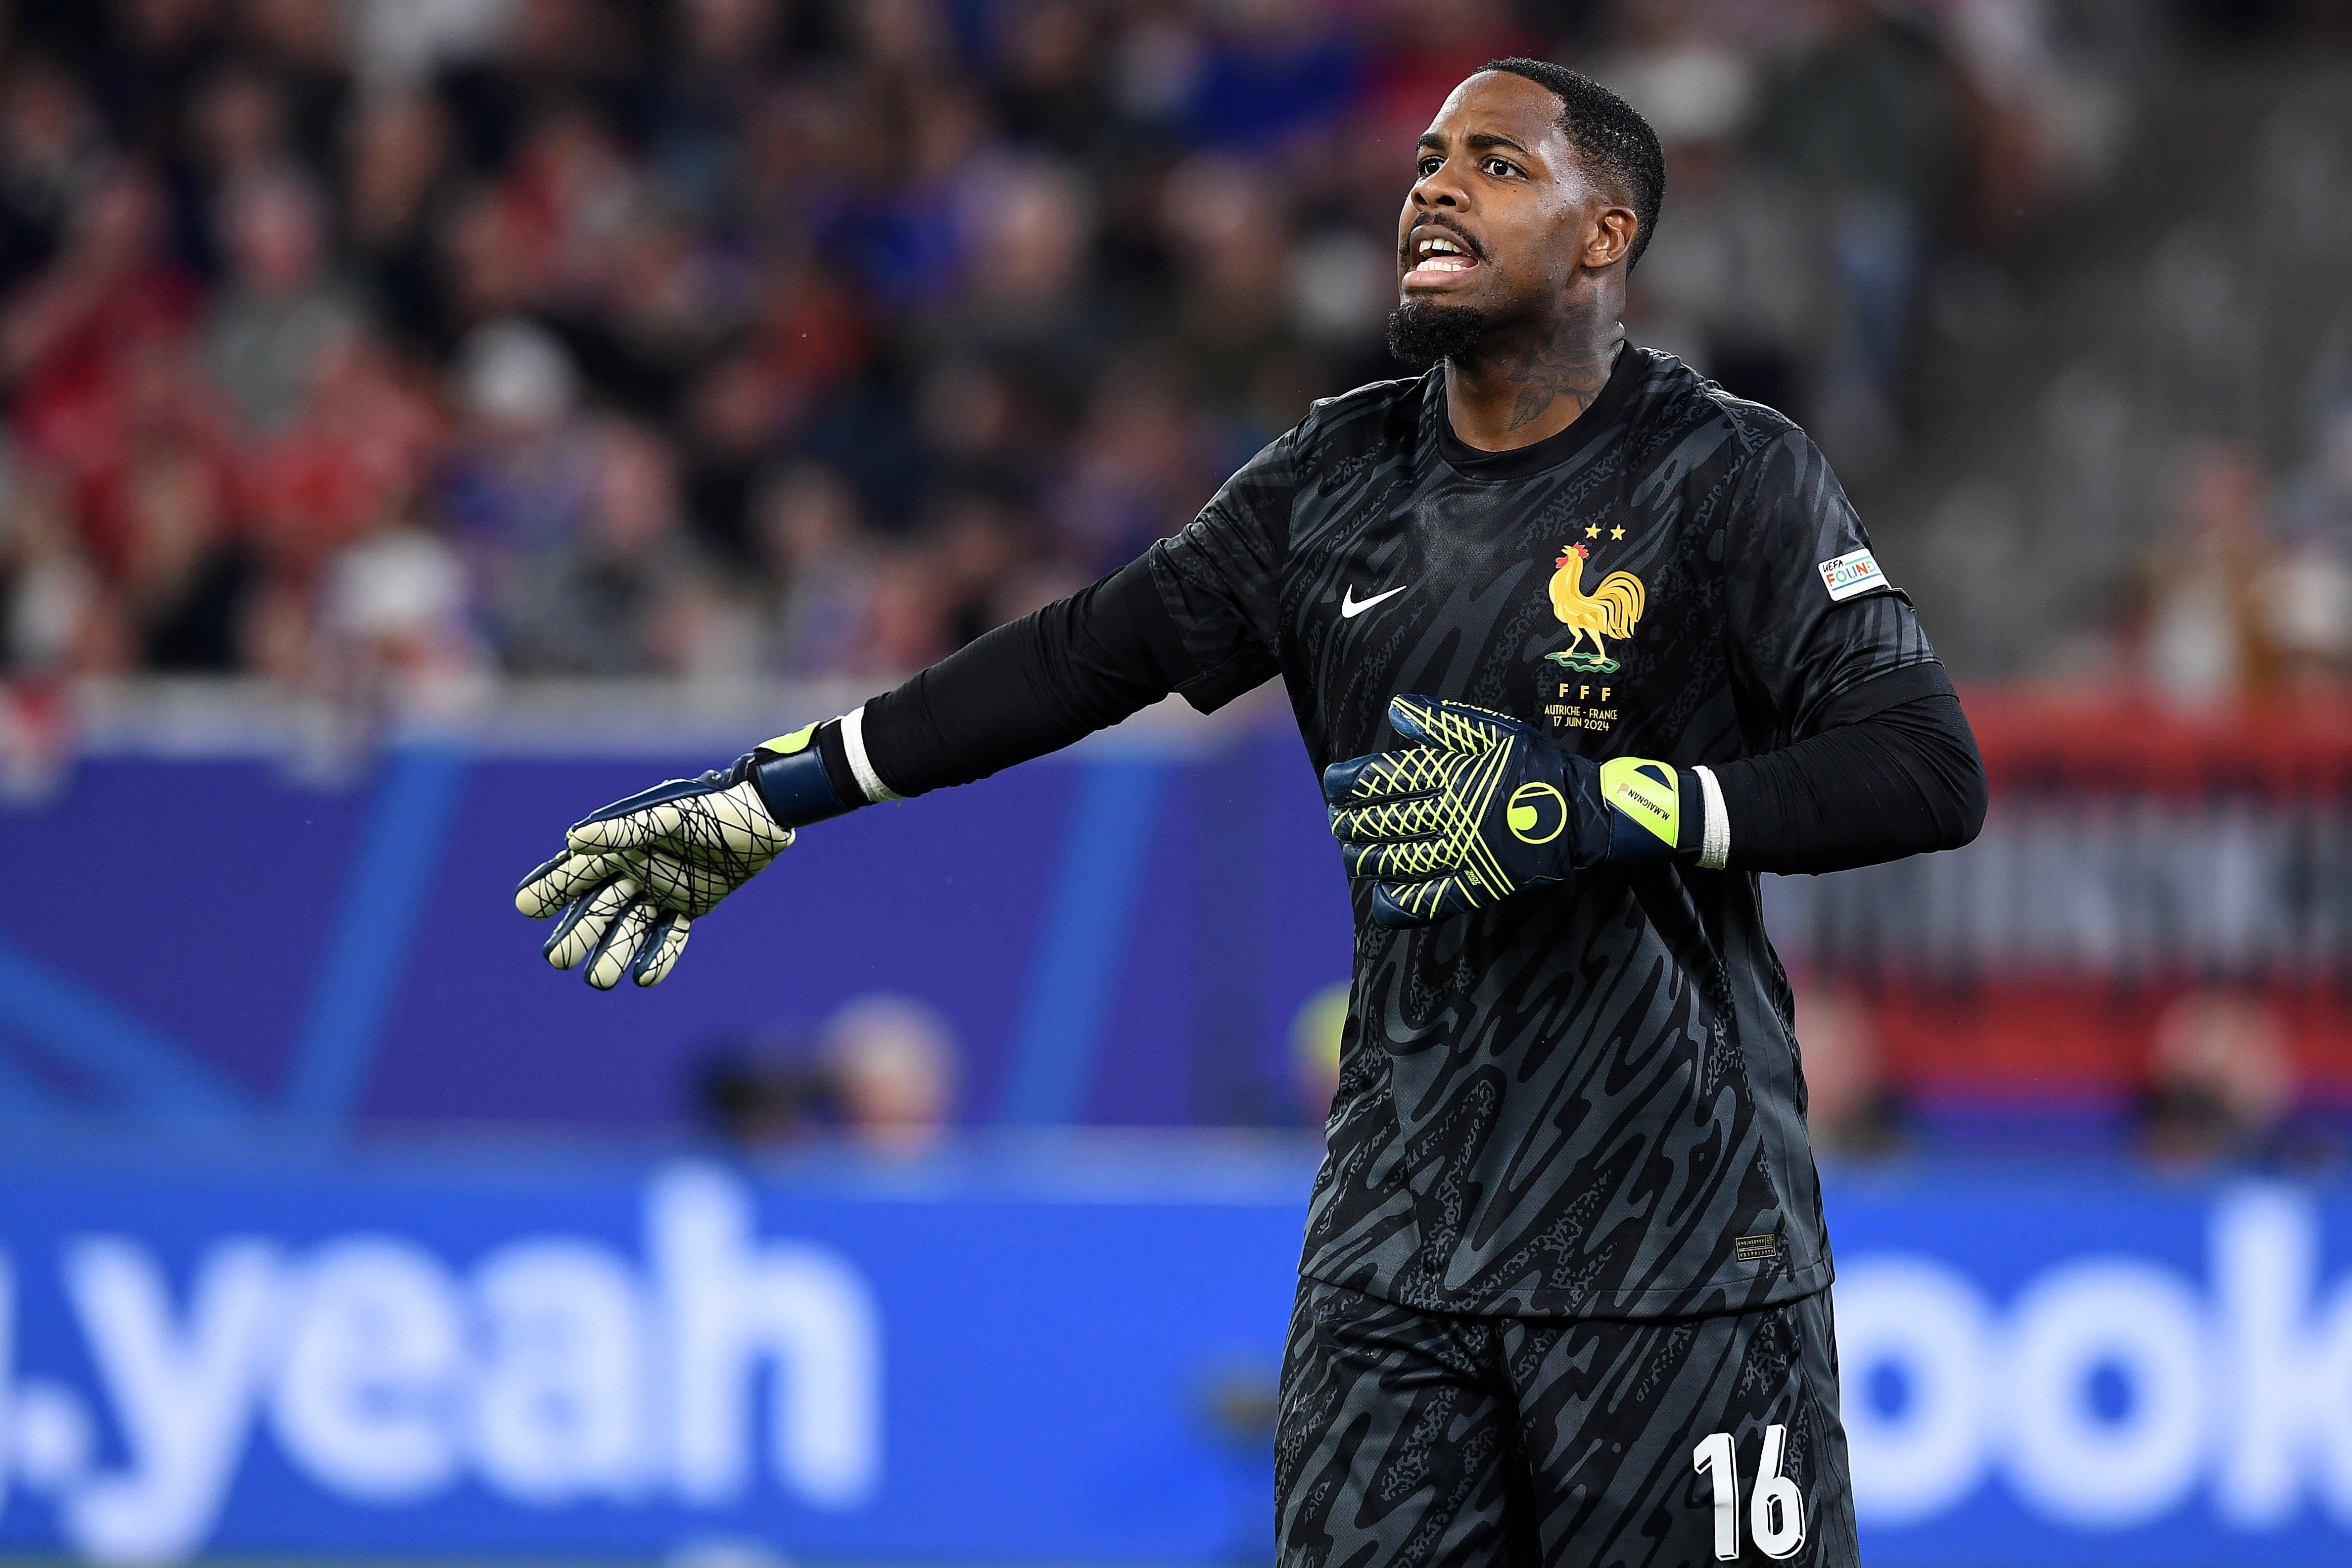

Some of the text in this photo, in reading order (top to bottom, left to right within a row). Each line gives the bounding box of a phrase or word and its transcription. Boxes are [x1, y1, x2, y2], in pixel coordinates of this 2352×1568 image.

[1823, 560, 1844, 572] UEFA
[1826, 561, 1879, 587] FOUND
[1544, 704, 1581, 716] AUTRICHE
[1589, 708, 1617, 720] FRANCE
[1553, 716, 1609, 731] 17 JUIN 2024
[1628, 790, 1670, 820] M.MAIGNAN
[1469, 870, 1481, 884] ZONE
[0, 1160, 883, 1568] .yeah
[1693, 1424, 1806, 1562] 16
